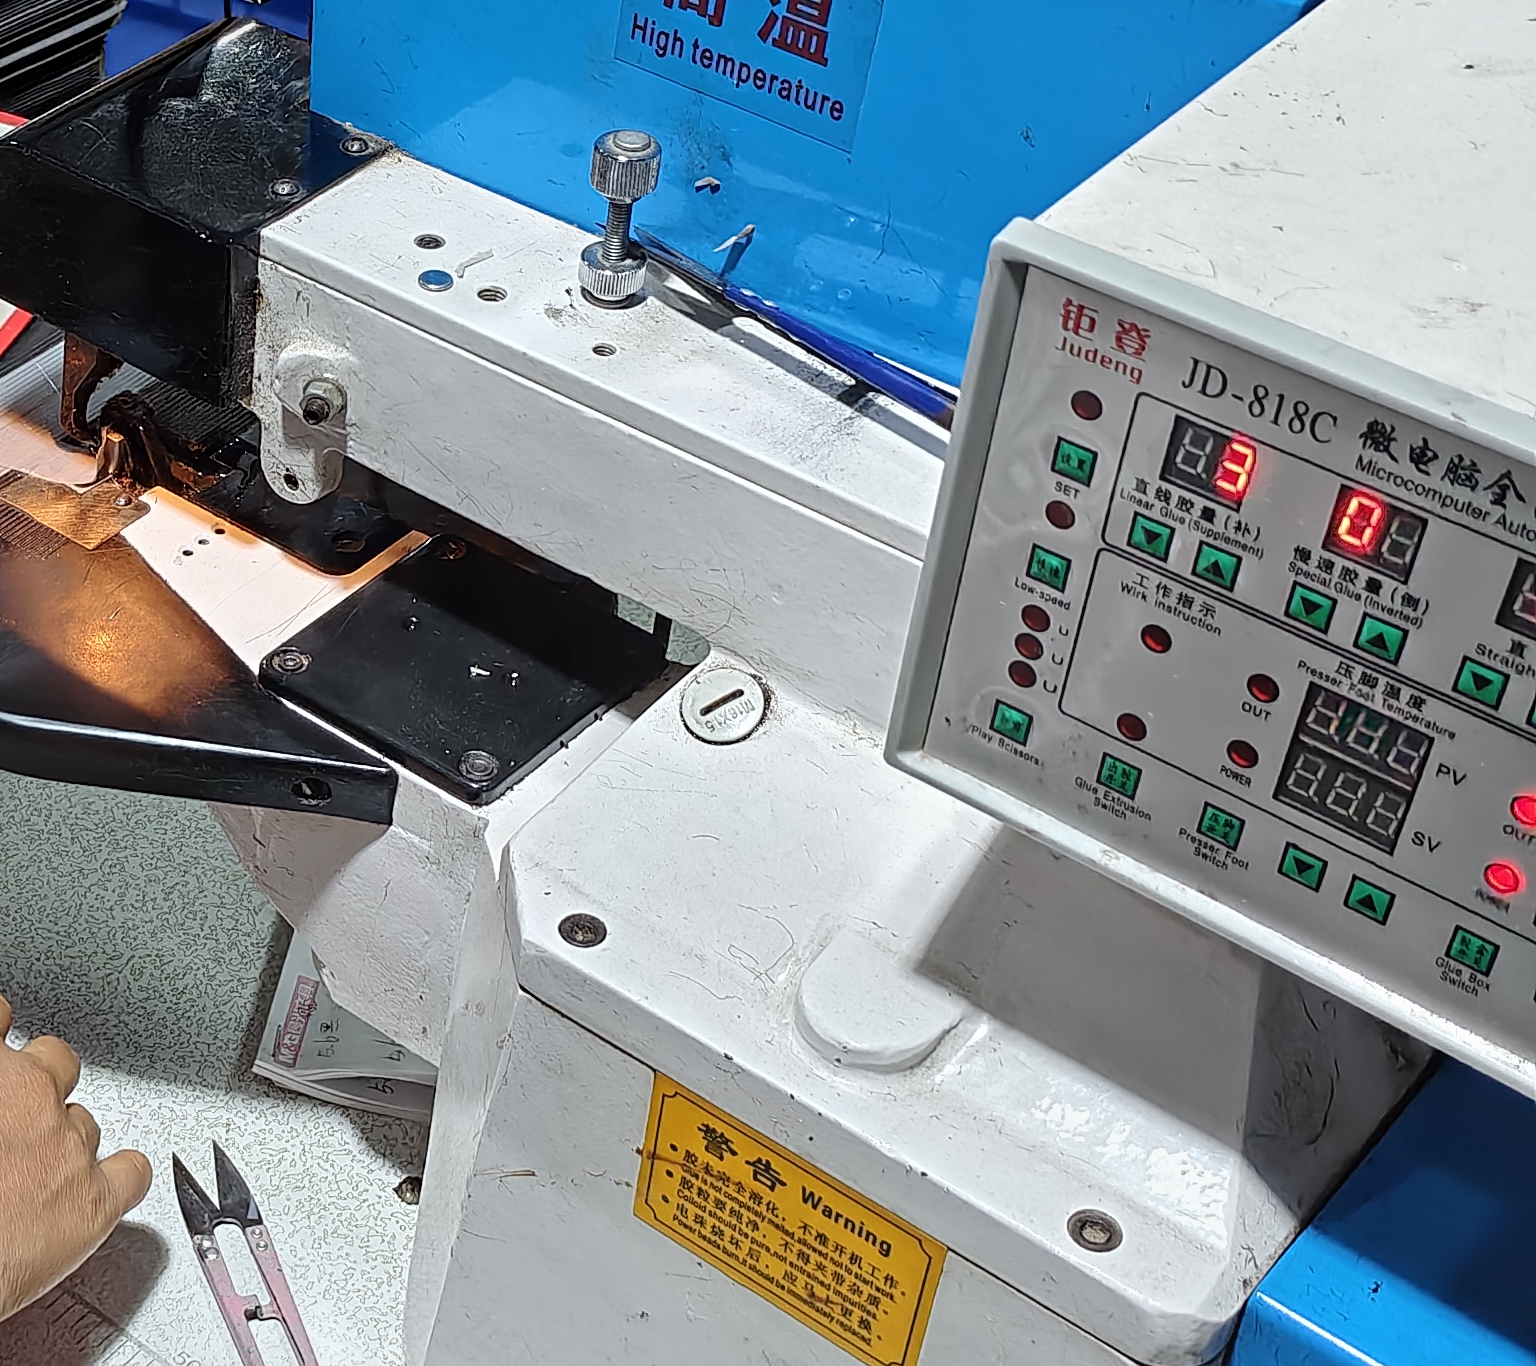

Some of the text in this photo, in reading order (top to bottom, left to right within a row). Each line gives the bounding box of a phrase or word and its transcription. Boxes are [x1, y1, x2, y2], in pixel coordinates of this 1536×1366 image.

[630, 13, 845, 121] High temperature
[1054, 336, 1144, 385] Judeng
[1181, 356, 1536, 515] JD-818C 微电脑全
[1054, 481, 1081, 500] SET
[1214, 439, 1256, 501] 3
[1354, 453, 1491, 523] Microcomputer
[1119, 487, 1264, 561] Linear Glue (Supplement)
[1014, 576, 1071, 611] Low-speed
[1132, 572, 1217, 620] 工作指示
[1287, 560, 1425, 630] Special Glue (Inverted)
[1241, 701, 1272, 723] OUT
[1297, 659, 1457, 740] Presser Foot Temperature
[1435, 762, 1468, 786] PV
[1074, 776, 1099, 795] Glue
[1102, 790, 1152, 822] Extrusion
[1179, 827, 1220, 855] Presser
[1225, 852, 1250, 871] Foot
[1193, 847, 1229, 871] Switch
[1411, 831, 1442, 854] SV
[1435, 956, 1491, 992] Glue Box
[1439, 971, 1479, 998] Switch
[697, 1122, 893, 1259] 警告 Warning
[709, 1180, 722, 1194] not
[676, 1188, 706, 1213] Colloid
[707, 1207, 737, 1232] should
[737, 1226, 749, 1240] be
[788, 1258, 831, 1291] entrained
